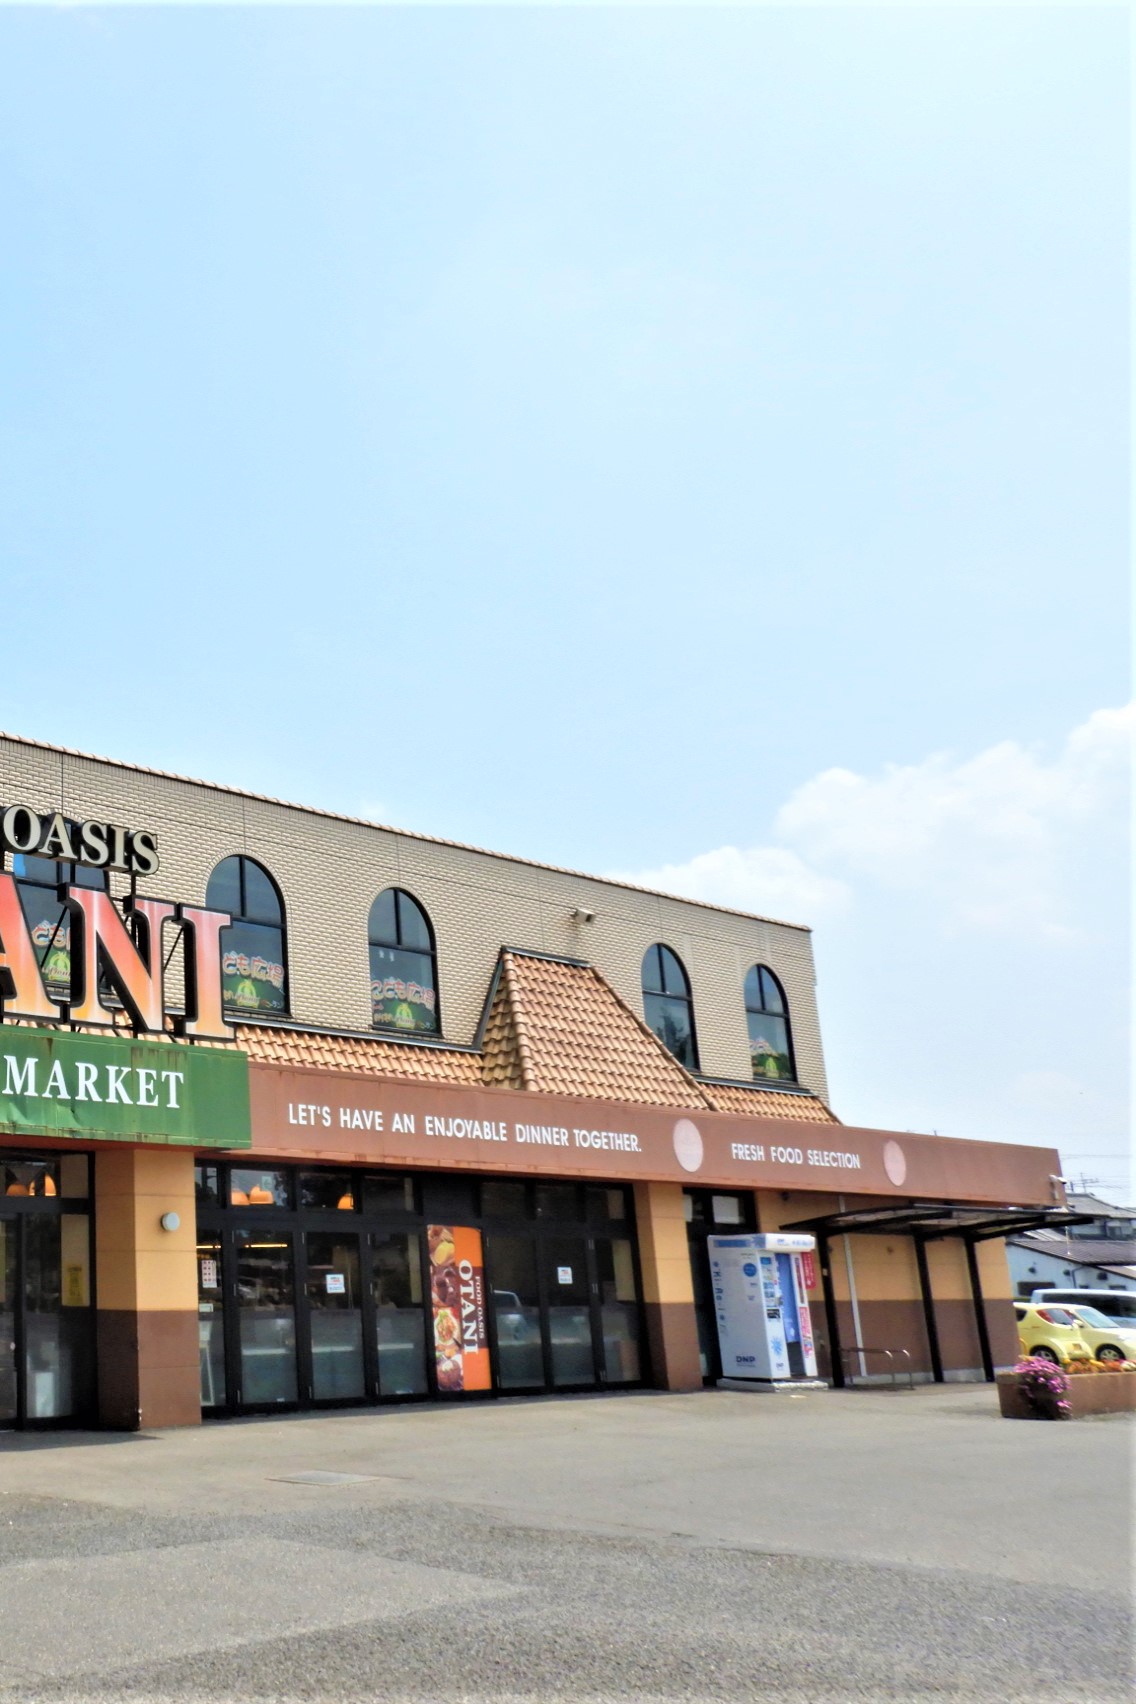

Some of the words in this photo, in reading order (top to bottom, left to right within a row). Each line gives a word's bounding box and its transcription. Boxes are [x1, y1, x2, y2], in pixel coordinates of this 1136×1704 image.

[2, 1054, 185, 1109] MARKET
[288, 1103, 331, 1127] LET'S
[339, 1107, 383, 1131] HAVE
[392, 1112, 415, 1133] AN
[425, 1115, 507, 1141] ENJOYABLE
[515, 1124, 569, 1146] DINNER
[573, 1129, 642, 1152] TOGETHER.
[731, 1143, 765, 1161] FRESH
[770, 1146, 803, 1165] FOOD
[807, 1149, 861, 1169] SELECTION
[459, 1259, 478, 1354] OTANI
[736, 1355, 755, 1363] DNP
